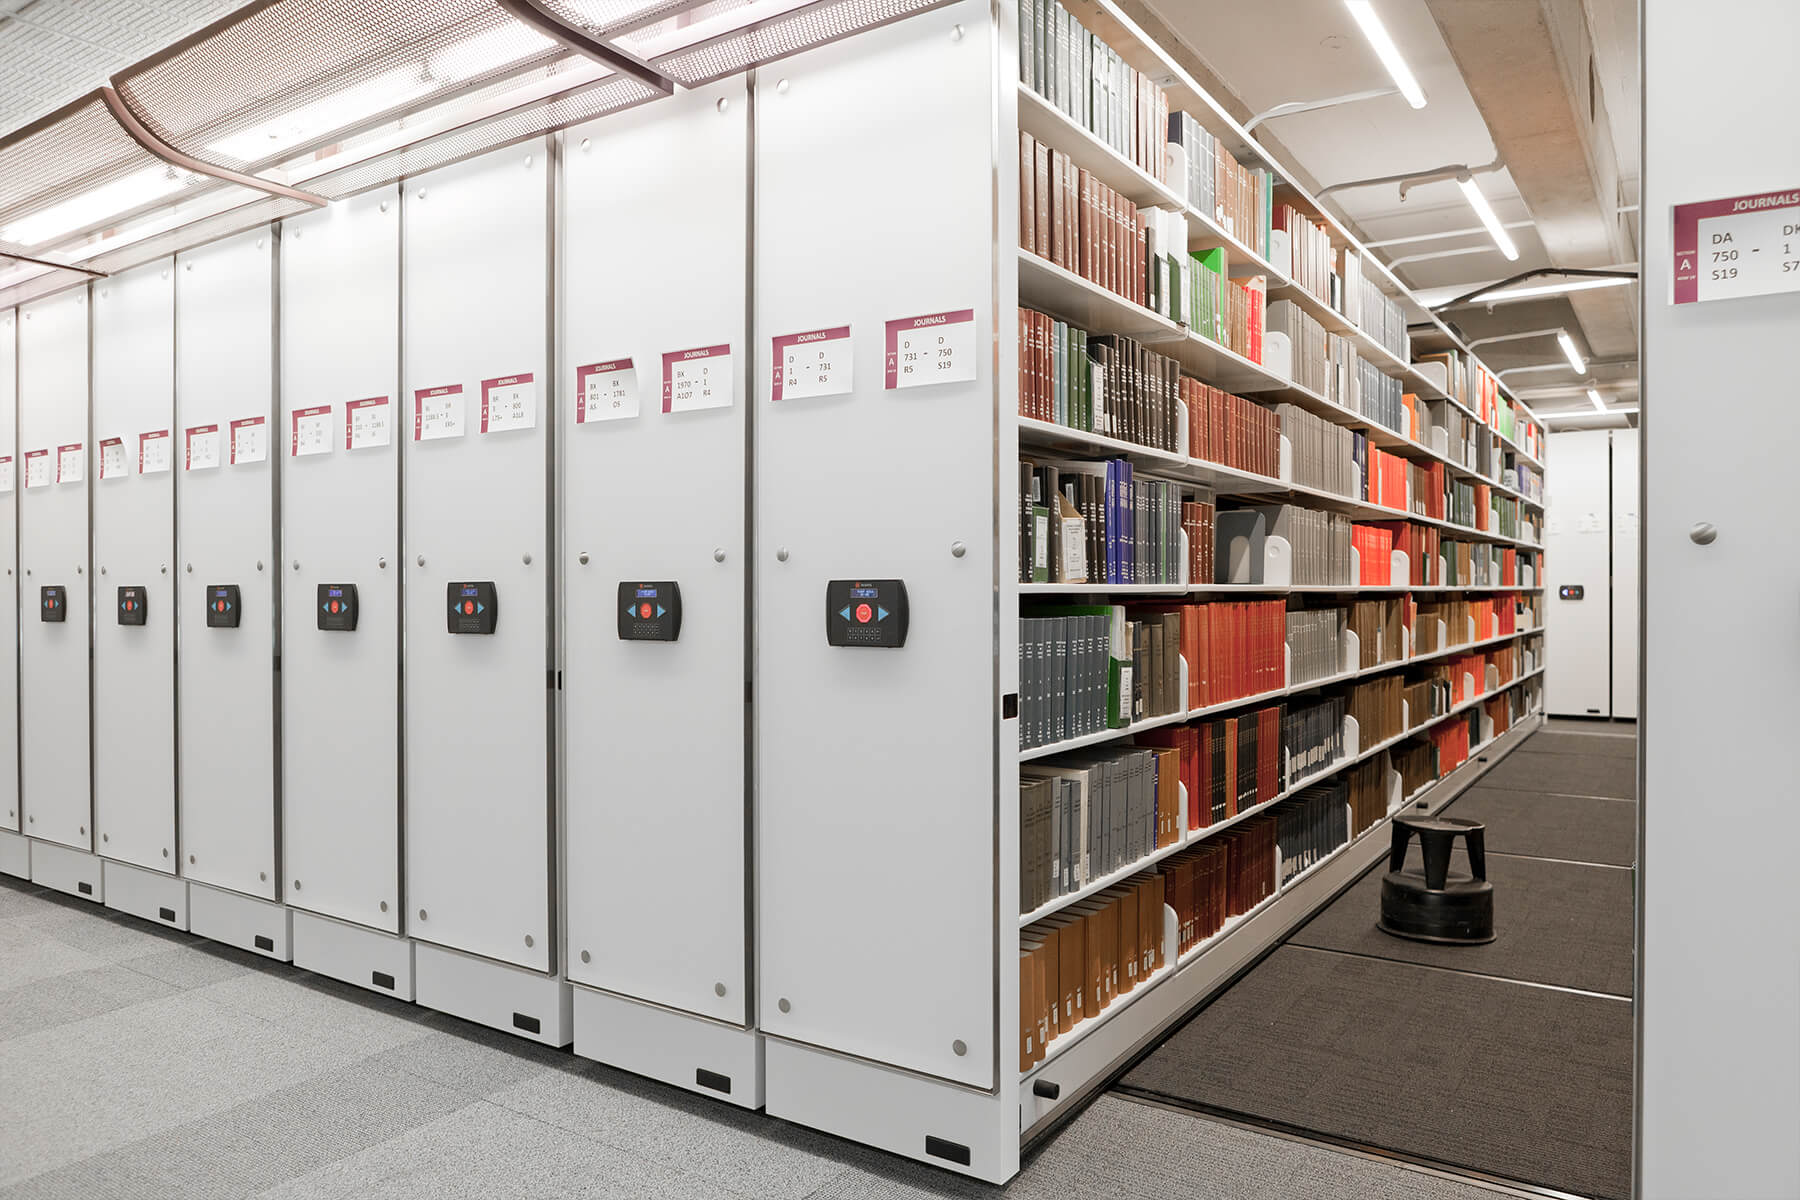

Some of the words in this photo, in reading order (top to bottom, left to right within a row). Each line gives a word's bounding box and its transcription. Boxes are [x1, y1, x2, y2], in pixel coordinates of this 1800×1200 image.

[1733, 193, 1799, 211] JOURNALS
[1712, 232, 1733, 245] DA
[1784, 243, 1791, 254] 1
[1712, 250, 1738, 263] 750
[1680, 259, 1692, 271] A
[1712, 268, 1738, 280] S19
[914, 316, 946, 327] JOURNALS
[797, 332, 827, 343] JOURNALS
[904, 341, 910, 349] D
[904, 353, 917, 361] 731
[938, 348, 952, 357] 750
[819, 363, 831, 371] 731
[888, 358, 895, 367] A
[937, 361, 952, 369] S19
